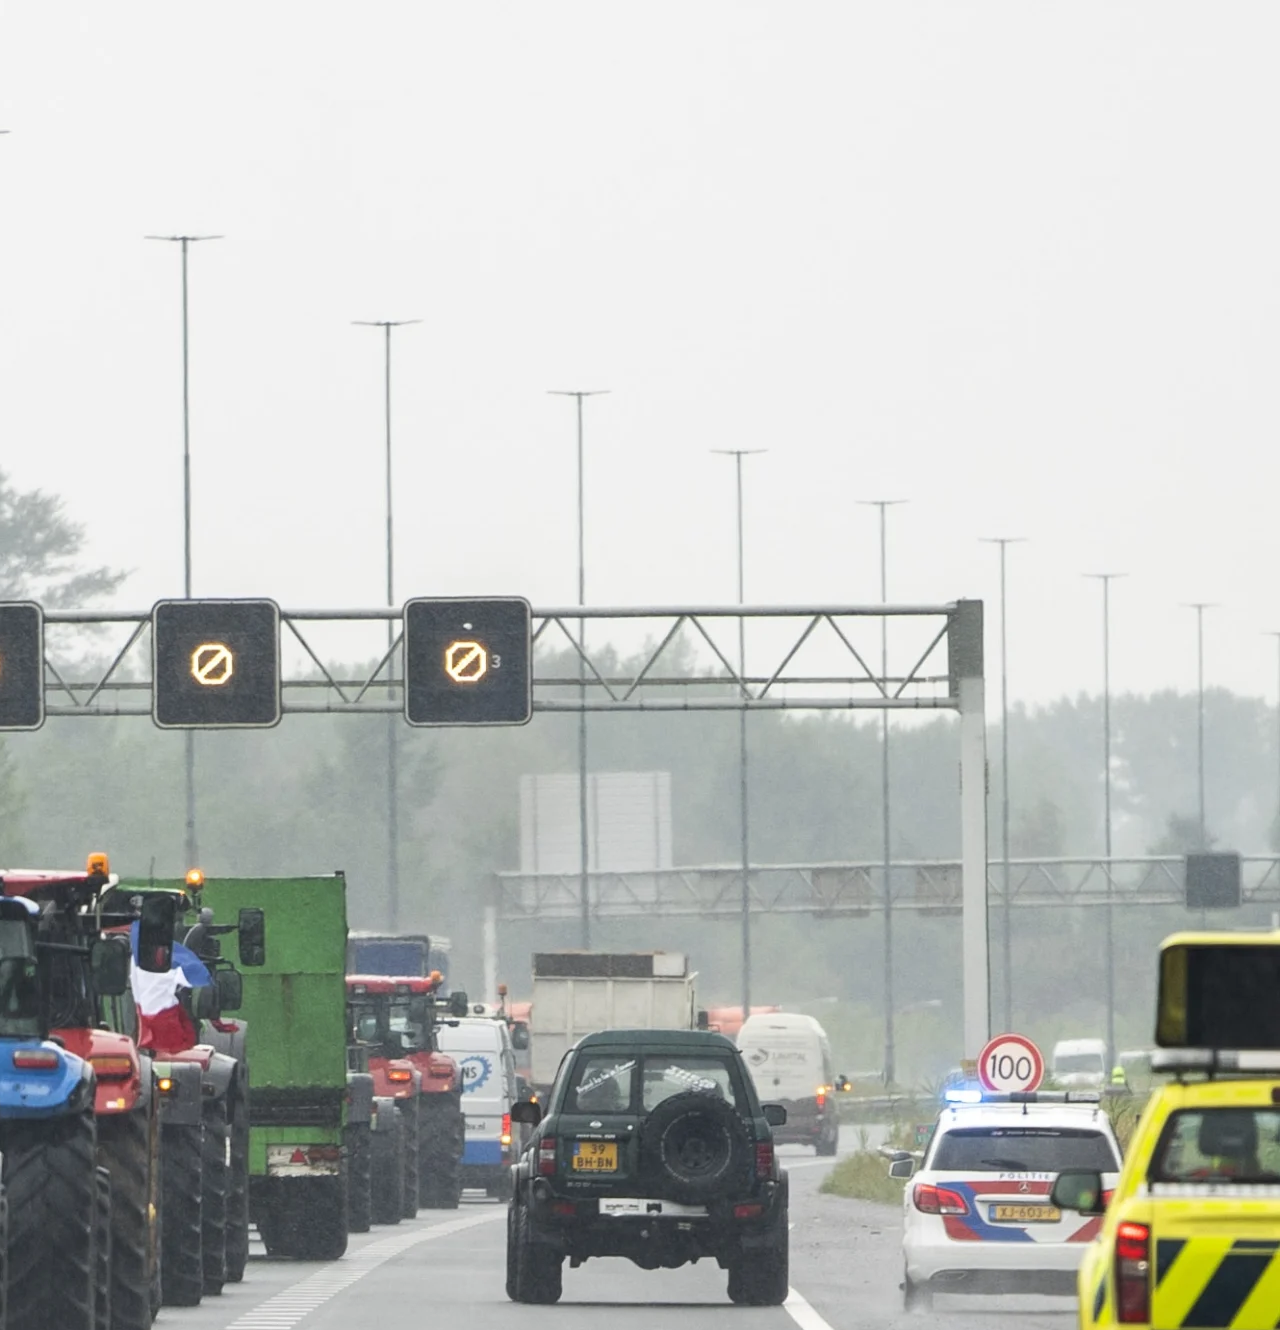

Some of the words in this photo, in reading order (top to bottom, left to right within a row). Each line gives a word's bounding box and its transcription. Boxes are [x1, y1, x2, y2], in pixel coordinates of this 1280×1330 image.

[491, 654, 501, 668] 3
[990, 1054, 1032, 1081] 100
[591, 1143, 606, 1155] 39
[576, 1156, 614, 1168] BH-BN
[999, 1172, 1050, 1180] POLITIE
